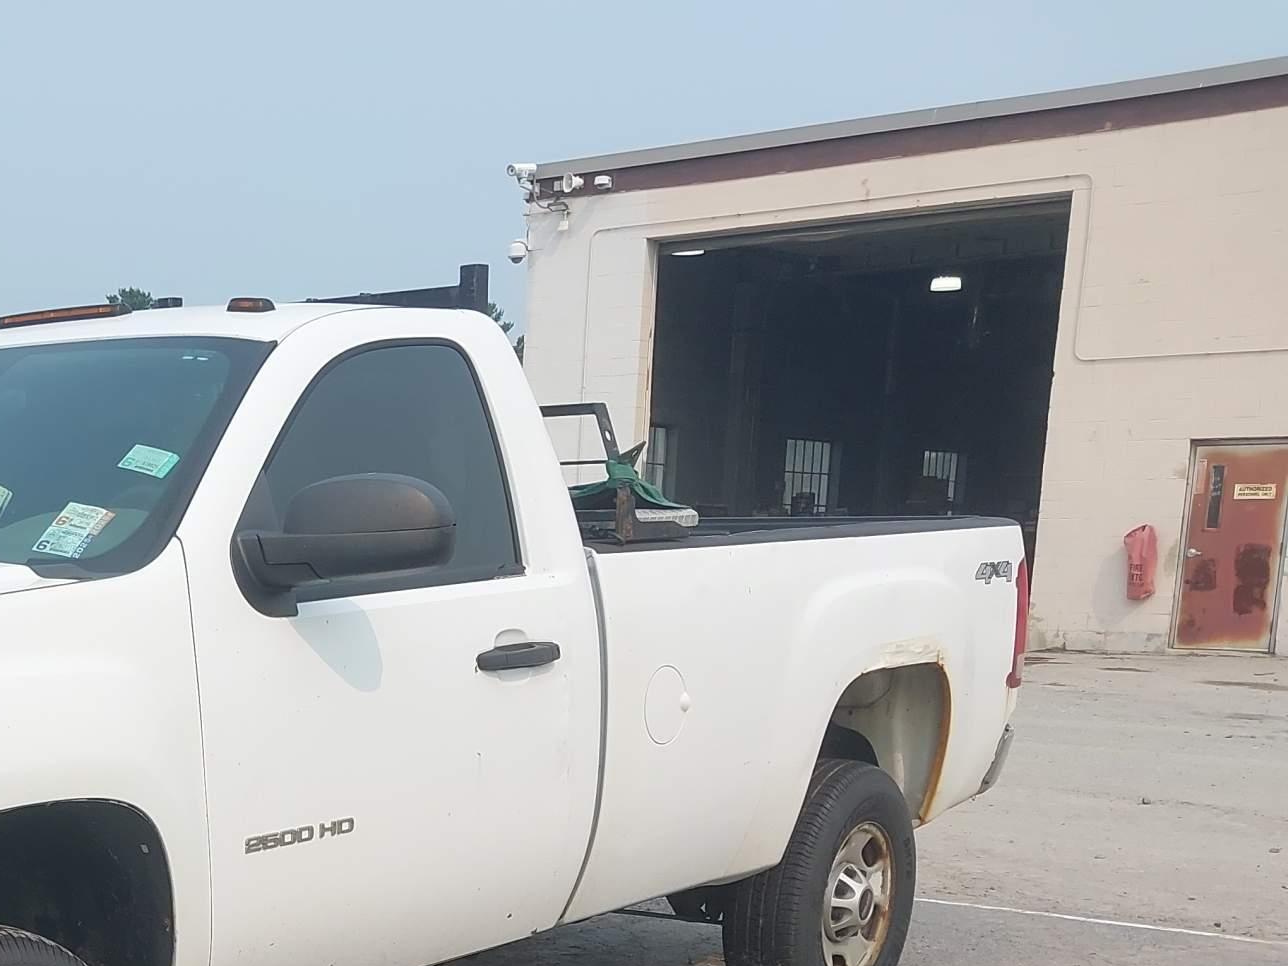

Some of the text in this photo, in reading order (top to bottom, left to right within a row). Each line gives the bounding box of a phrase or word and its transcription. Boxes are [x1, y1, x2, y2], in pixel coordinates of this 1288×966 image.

[36, 540, 52, 551] 6
[244, 817, 354, 854] 2500 HD
